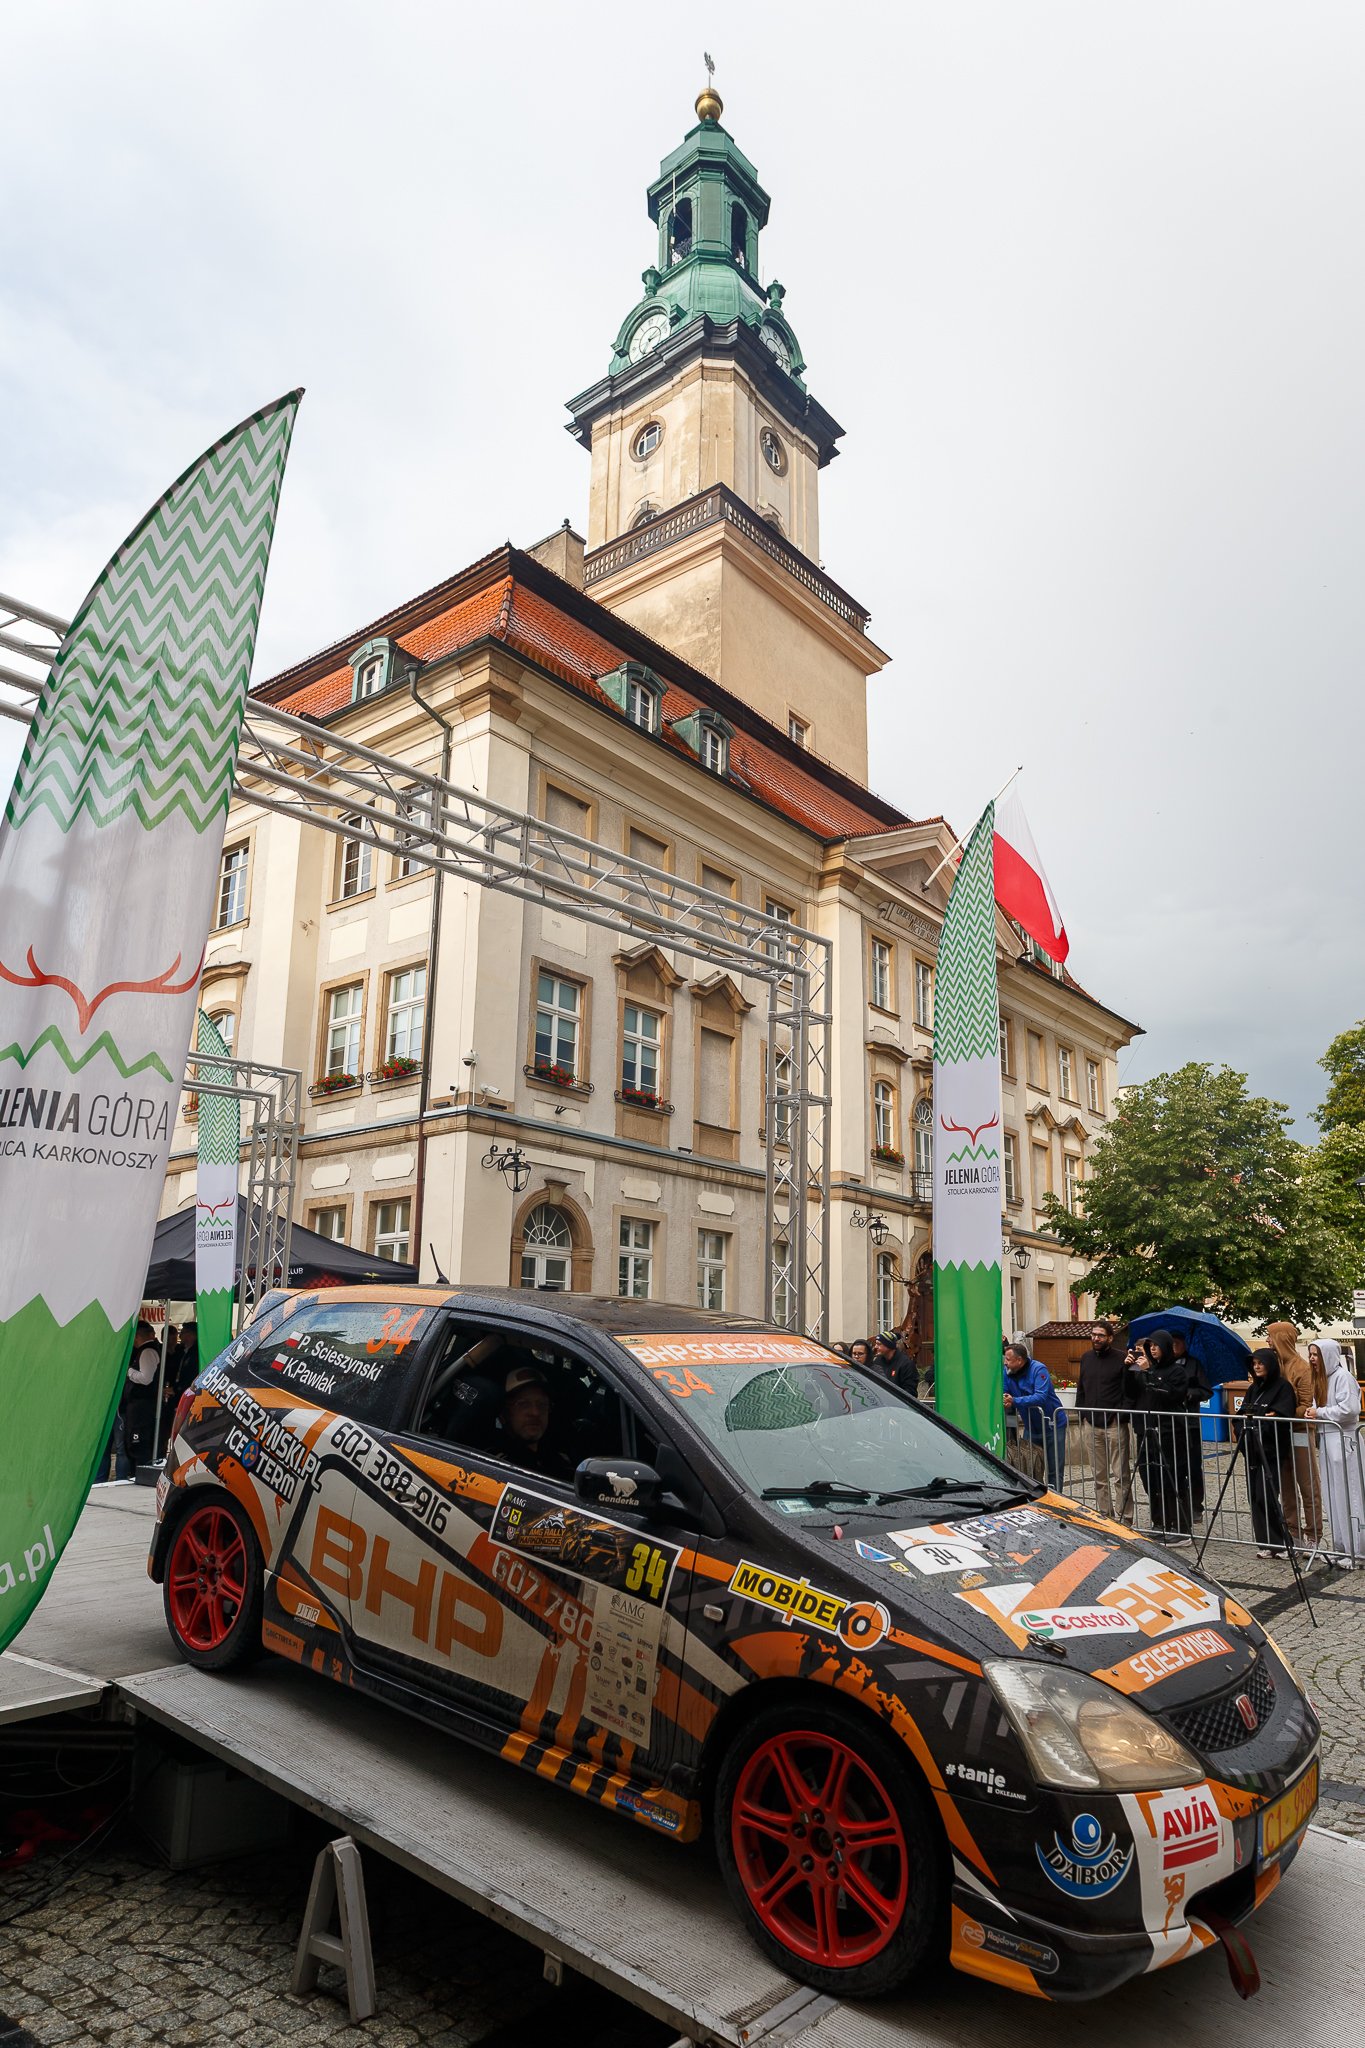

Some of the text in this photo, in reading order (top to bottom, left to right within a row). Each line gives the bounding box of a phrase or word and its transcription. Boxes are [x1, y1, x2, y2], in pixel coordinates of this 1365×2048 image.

[0, 1088, 168, 1141] LENIA GÓRA
[32, 1142, 158, 1170] KARKONOSZY
[945, 1168, 980, 1185] JELENIA
[366, 1307, 426, 1355] 34
[312, 1339, 384, 1382] Scieszynski
[654, 1368, 716, 1398] 34
[202, 1365, 321, 1491] BHP.SCIESZYNSKI.PL
[225, 1425, 295, 1500] ICE TERM
[330, 1422, 452, 1535] 602 388 916
[510, 1496, 527, 1508] AMG
[598, 1493, 640, 1506] Genderka
[953, 1520, 996, 1540] ICE
[625, 1542, 668, 1600] 34
[922, 1546, 963, 1566] 34
[309, 1504, 505, 1658] BHP
[620, 1599, 646, 1620] AMG
[1051, 1611, 1132, 1630] Castrol
[1097, 1571, 1211, 1638] BHP
[1128, 1630, 1229, 1684] SCIESZYNSKI
[945, 1763, 1006, 1788] #tanie
[1043, 1847, 1129, 1885] DABOR
